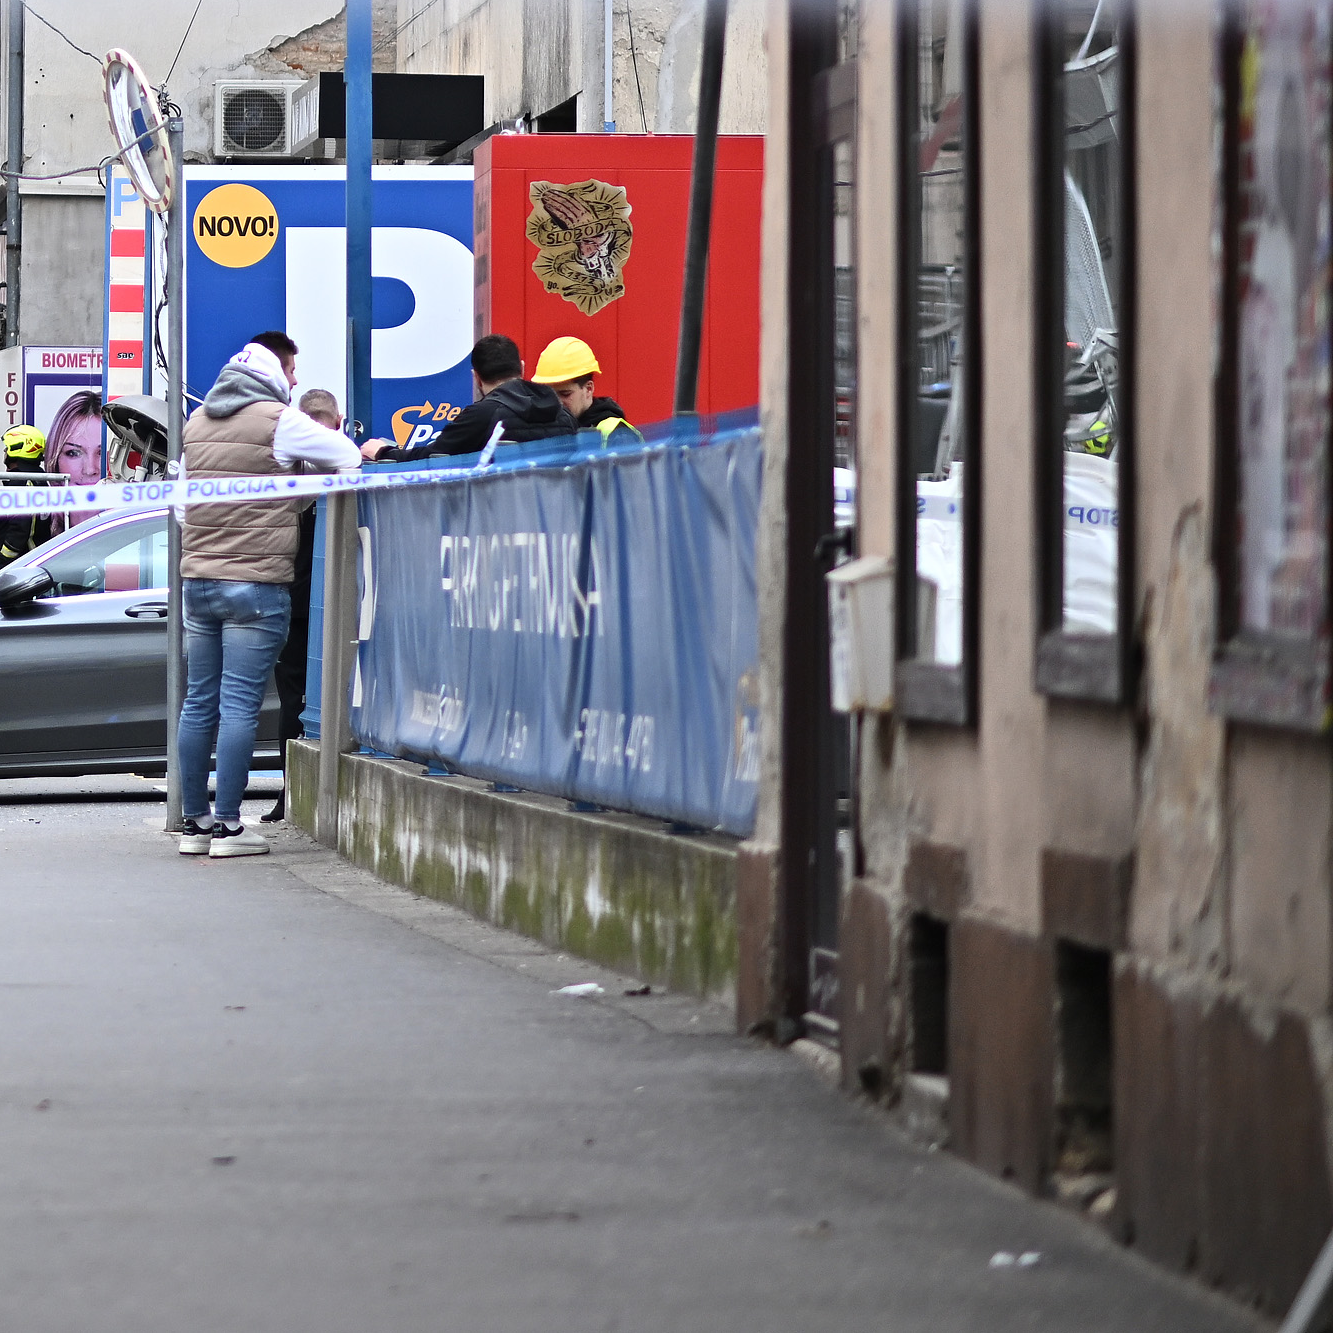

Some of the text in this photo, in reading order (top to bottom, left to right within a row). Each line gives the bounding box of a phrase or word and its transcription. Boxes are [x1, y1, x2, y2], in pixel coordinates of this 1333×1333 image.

[199, 216, 274, 237] NOVO!
[546, 221, 618, 244] SLOBODA
[41, 352, 104, 368] BIOMETR
[4, 372, 19, 425] FOT
[432, 402, 461, 421] Be
[122, 483, 174, 502] STOP
[187, 478, 277, 497] POLICIJA
